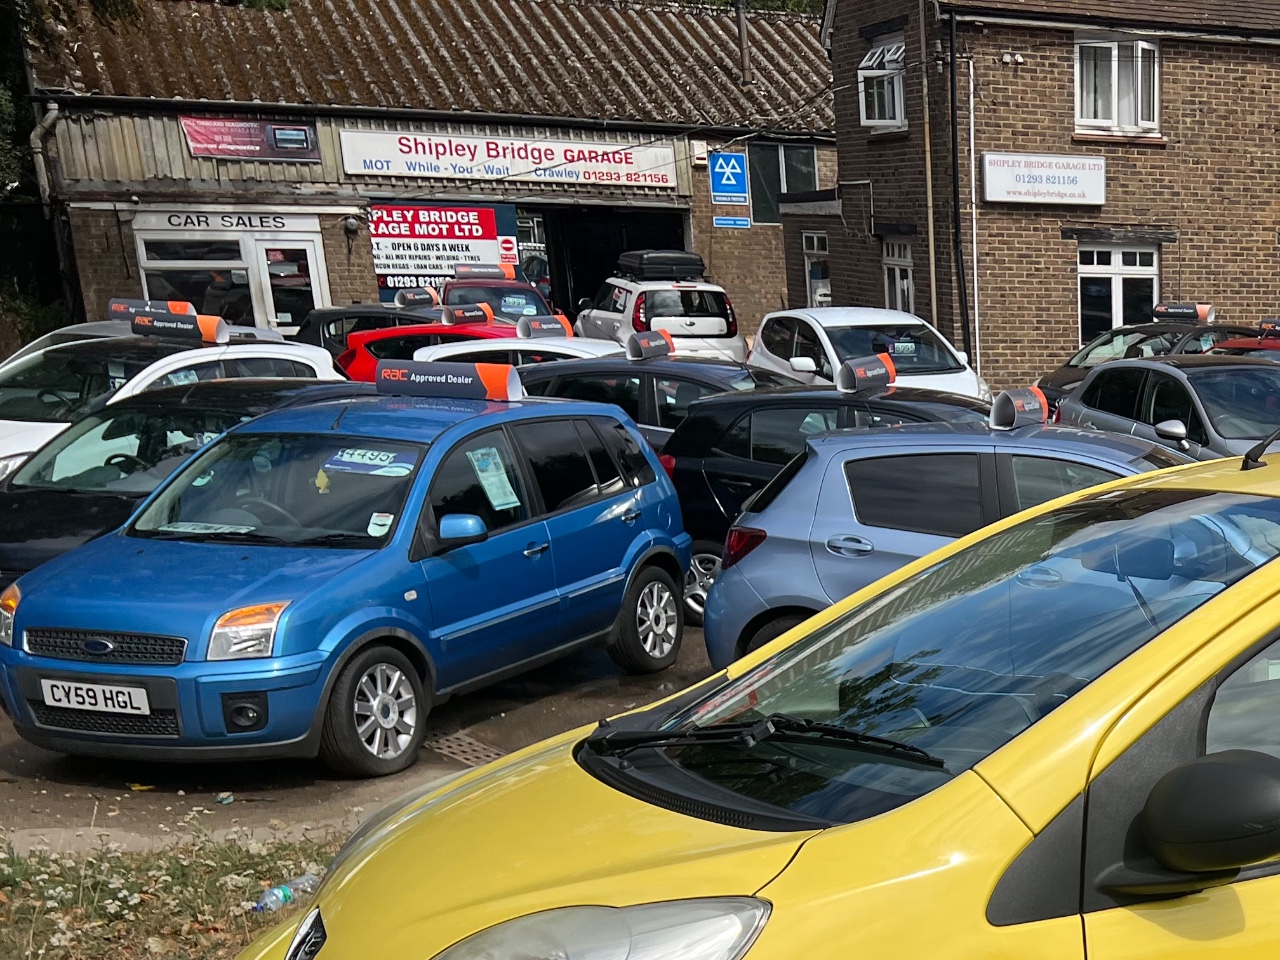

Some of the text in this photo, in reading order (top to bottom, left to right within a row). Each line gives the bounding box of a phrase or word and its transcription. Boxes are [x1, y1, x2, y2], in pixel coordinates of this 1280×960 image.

[398, 136, 634, 165] Shipley Bridge GARAGE
[988, 159, 1103, 171] SHIPLEY BRIDGE GARAGE LTD
[362, 159, 392, 171] MOT
[405, 160, 440, 173] While
[450, 163, 473, 174] You
[483, 164, 510, 176] Wait
[534, 167, 580, 181] Crawley
[583, 170, 621, 181] 01293
[626, 172, 669, 184] 821156
[1015, 174, 1078, 185] 01293 821156
[1006, 189, 1087, 199] www.shipleybridge.co.uk
[167, 214, 286, 228] CAR SALES
[418, 210, 479, 223] BRIDGE
[414, 224, 449, 236] MOT
[454, 225, 483, 237] LTD
[391, 242, 412, 251] OPEN
[421, 243, 440, 252] DAYS
[442, 244, 447, 252] A
[448, 244, 471, 252] WEEK
[386, 276, 418, 288] 01293
[153, 320, 177, 330] Approved
[177, 321, 195, 330] Dealer
[411, 373, 446, 384] Approved
[447, 374, 473, 384] Dealer
[50, 684, 142, 711] CY59 HGL
